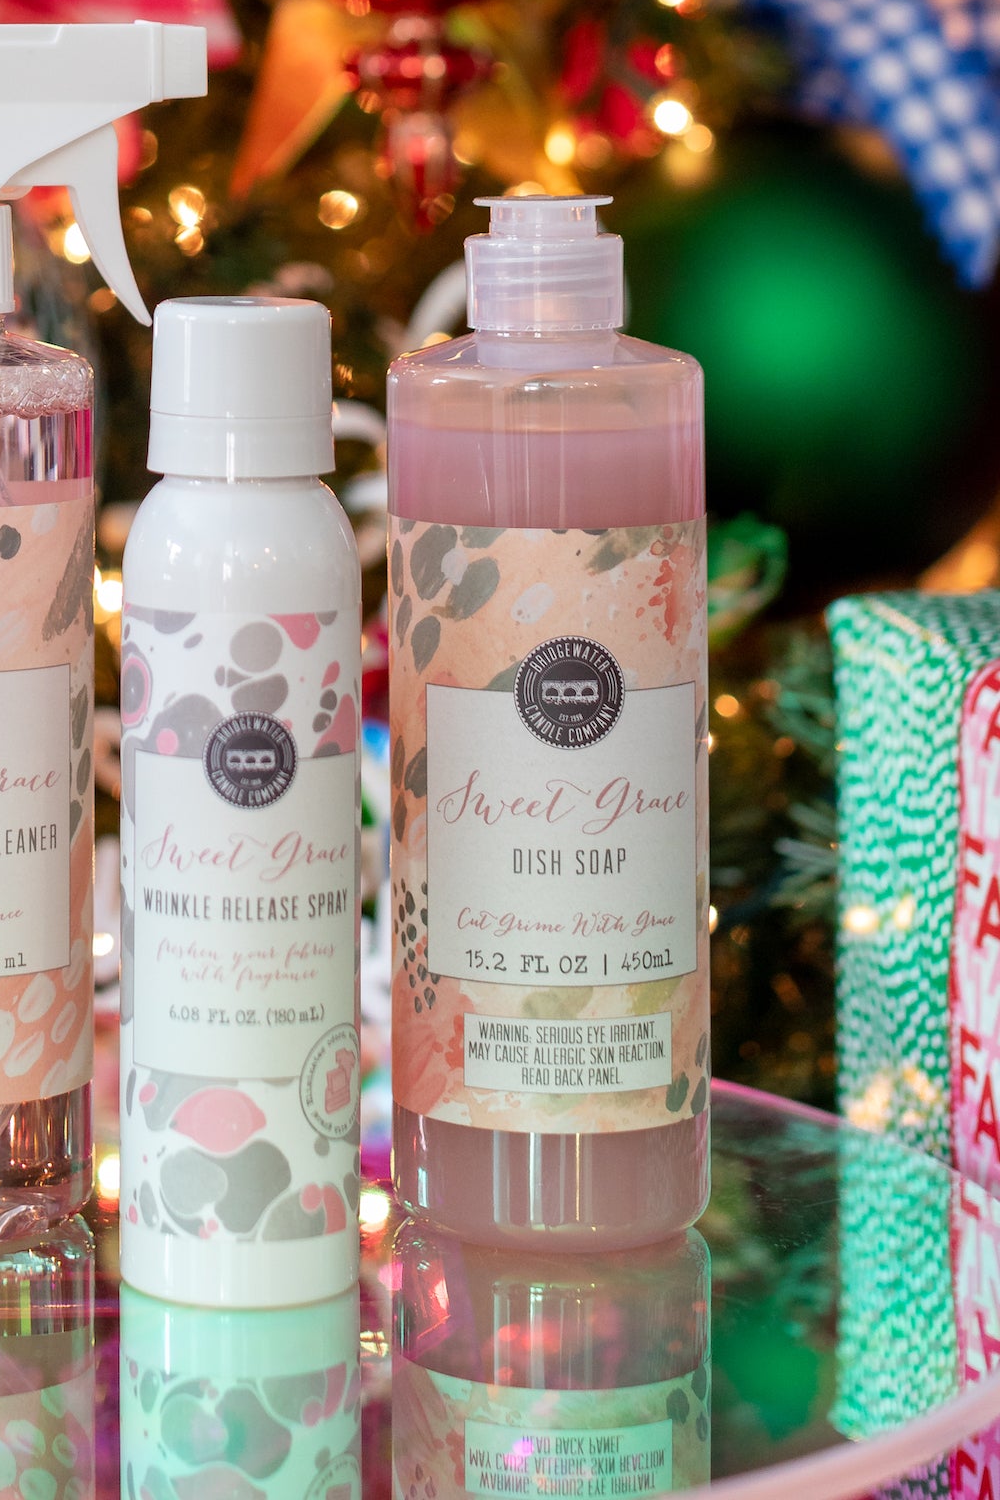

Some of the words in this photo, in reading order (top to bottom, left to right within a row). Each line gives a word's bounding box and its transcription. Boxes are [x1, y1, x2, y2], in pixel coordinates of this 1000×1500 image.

[529, 643, 610, 673] BRIDGEWATER
[216, 717, 286, 742] BRIDGEWATER
[525, 704, 563, 741] CANDLE
[568, 703, 615, 742] COMPANY
[211, 770, 244, 803] CANDLE
[248, 769, 289, 804] COMPANY
[437, 769, 591, 825] Sweet
[582, 776, 689, 835] Grace
[141, 823, 268, 872] Sweet
[259, 831, 349, 882] Grace
[513, 848, 561, 875] DISH
[575, 848, 626, 875] SOAP
[144, 886, 210, 920] WRINKLE
[222, 895, 299, 922] RELEASE
[308, 888, 348, 918] SPRAY
[457, 906, 497, 930] Cut
[494, 911, 565, 938] Grime
[572, 910, 630, 938] With
[631, 910, 677, 937] Grace
[5, 953, 27, 969] ml
[466, 949, 507, 971] 15.2
[520, 954, 549, 973] FL
[559, 956, 588, 974] OZ
[621, 948, 674, 972] 450ml
[169, 1004, 200, 1021] 6.08
[208, 1008, 230, 1024] FL
[235, 1010, 261, 1025] OZ.
[478, 1021, 532, 1043] WARNING:
[536, 1026, 583, 1044] SERIOUS
[587, 1026, 605, 1044] EYE
[610, 1021, 657, 1043] IRRITANT.
[469, 1041, 491, 1061] MAY
[494, 1044, 529, 1064] CAUSE
[534, 1047, 586, 1065] ALLERGIC
[590, 1046, 615, 1065] SKIN
[619, 1041, 666, 1063] REACTION.
[522, 1068, 550, 1086] READ
[555, 1068, 584, 1087] BACK
[588, 1067, 624, 1086] PANEL.
